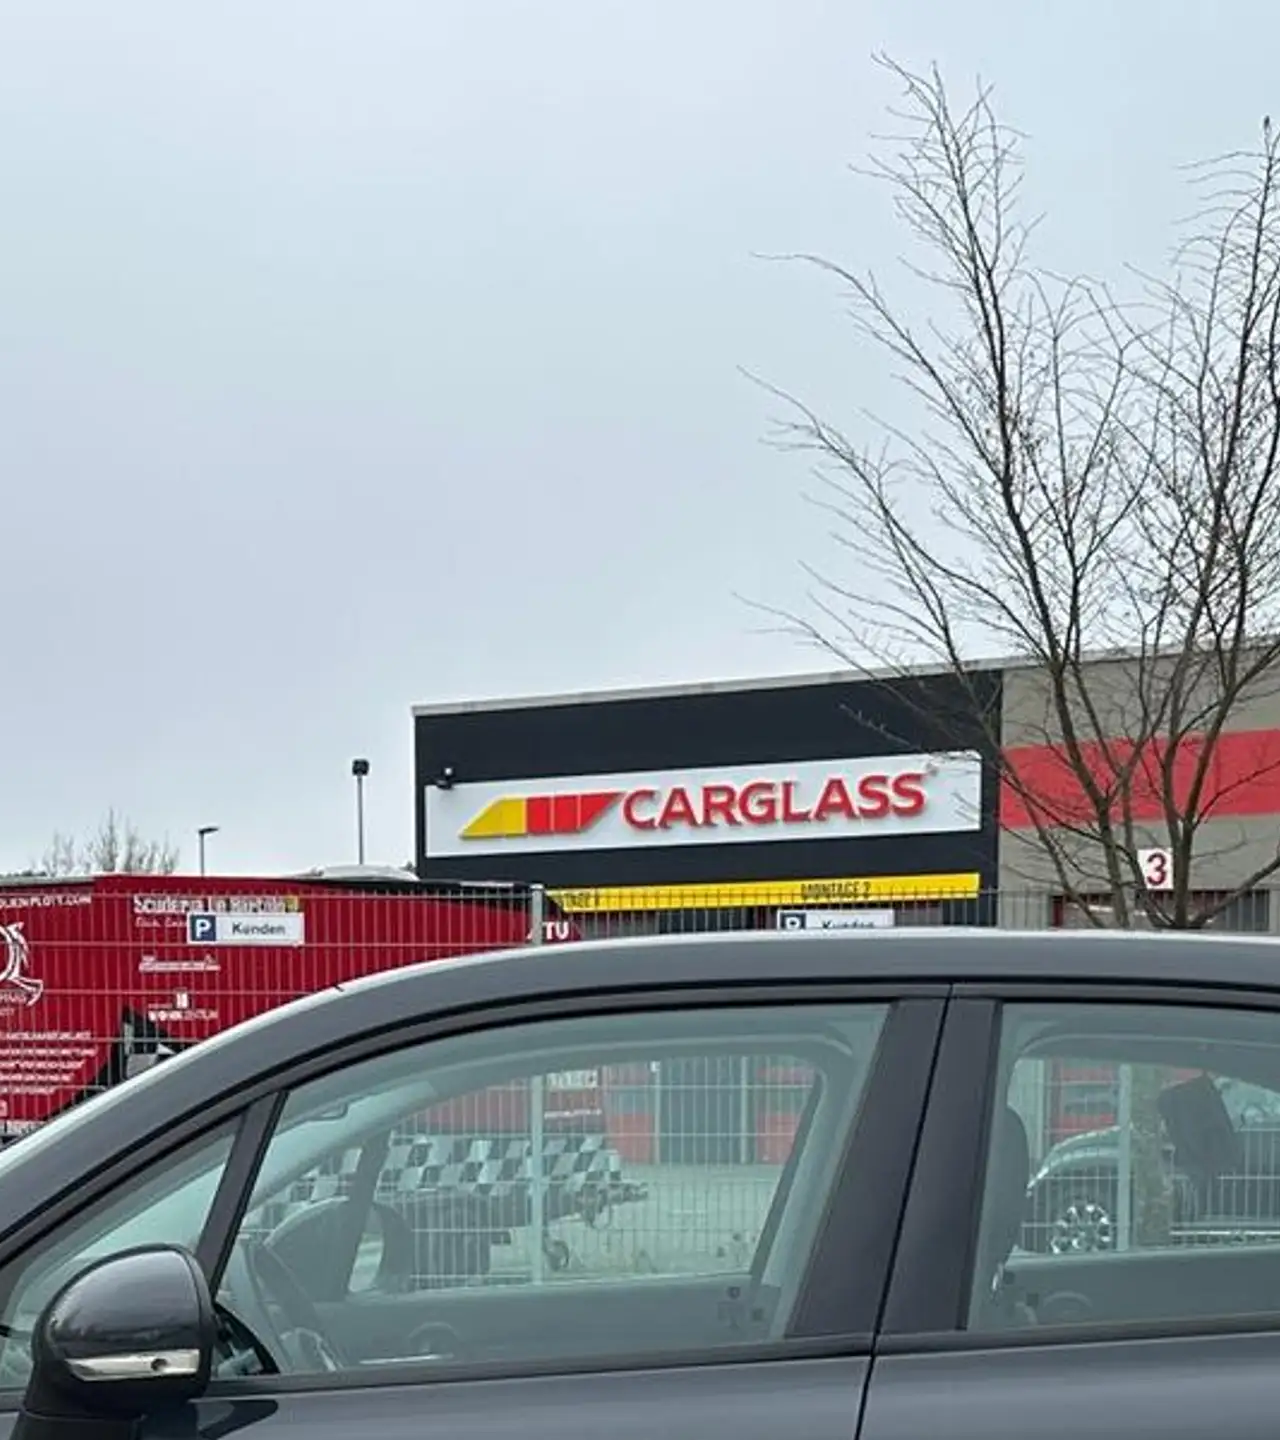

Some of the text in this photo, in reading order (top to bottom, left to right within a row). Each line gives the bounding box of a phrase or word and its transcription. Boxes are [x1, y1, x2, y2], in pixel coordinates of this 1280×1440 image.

[623, 773, 926, 830] CARGLASS
[1147, 852, 1167, 887] 3
[232, 922, 285, 935] Kunden
